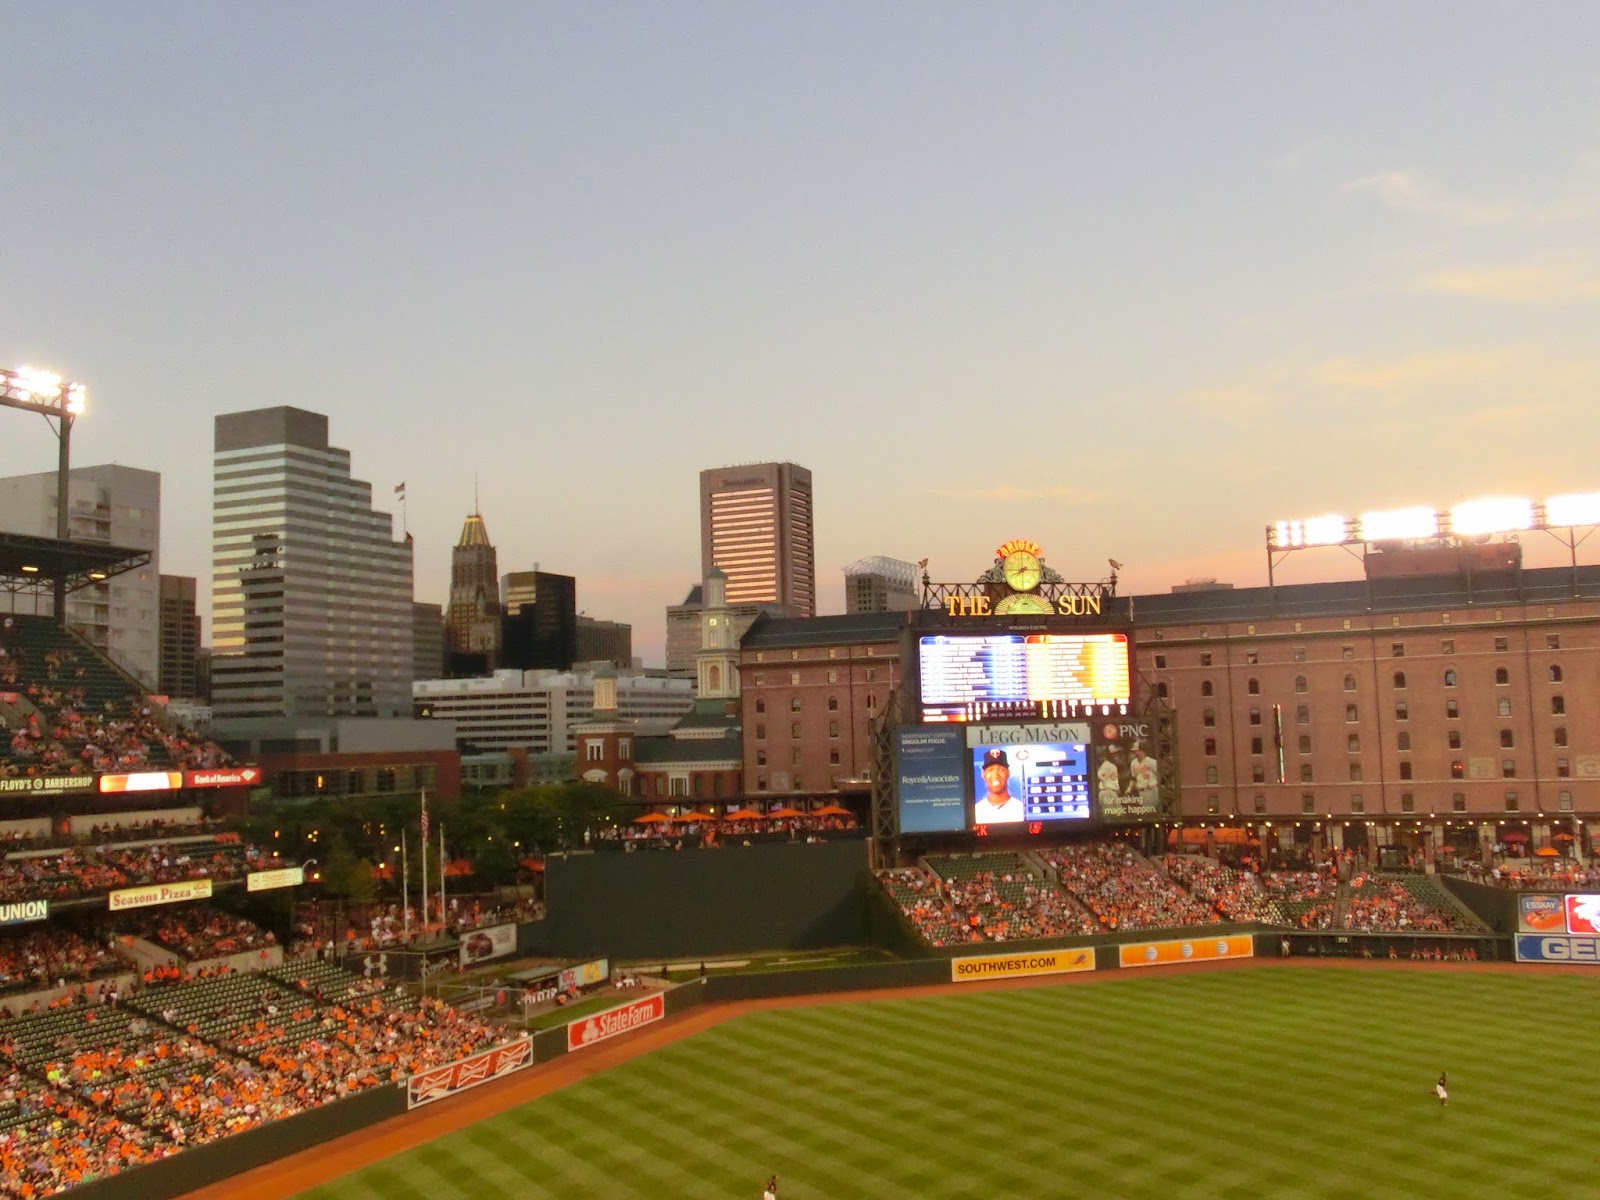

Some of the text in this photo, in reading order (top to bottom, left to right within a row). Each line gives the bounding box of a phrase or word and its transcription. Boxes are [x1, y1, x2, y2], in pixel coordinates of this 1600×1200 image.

[945, 595, 1101, 616] THE SUN
[979, 728, 1079, 744] LEGG MASON
[1119, 724, 1149, 737] PNC
[0, 777, 93, 791] FLOYD'S BARBERSHOP
[195, 775, 209, 784] Bank
[217, 774, 241, 783] America
[1116, 795, 1143, 805] making
[1104, 806, 1127, 816] magic
[113, 893, 158, 907] Seasons
[160, 887, 192, 901] Pizza
[0, 900, 47, 921] UNION
[1525, 901, 1556, 909] ESSKAY
[958, 957, 1056, 974] SOUTHWEST.COM
[600, 1004, 654, 1036] State Farm
